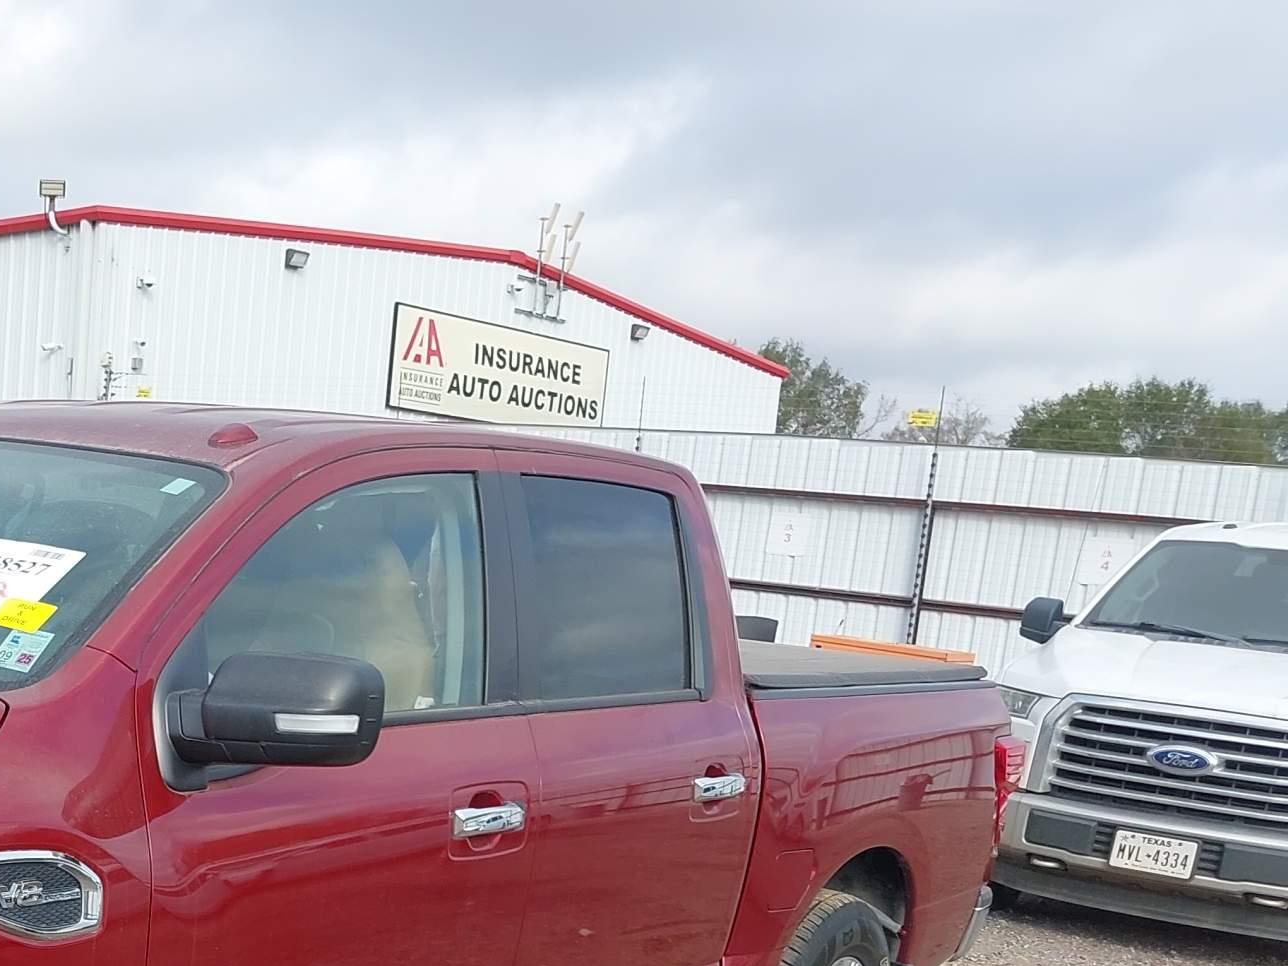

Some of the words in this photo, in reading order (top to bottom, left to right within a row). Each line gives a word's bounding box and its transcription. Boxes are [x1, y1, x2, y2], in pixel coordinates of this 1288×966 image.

[474, 343, 581, 385] INSURANCE
[447, 373, 501, 402] AUTO
[507, 384, 598, 420] AUCTIONS
[17, 652, 34, 665] 25
[1162, 752, 1199, 768] Ford
[1142, 836, 1172, 848] TEXAS
